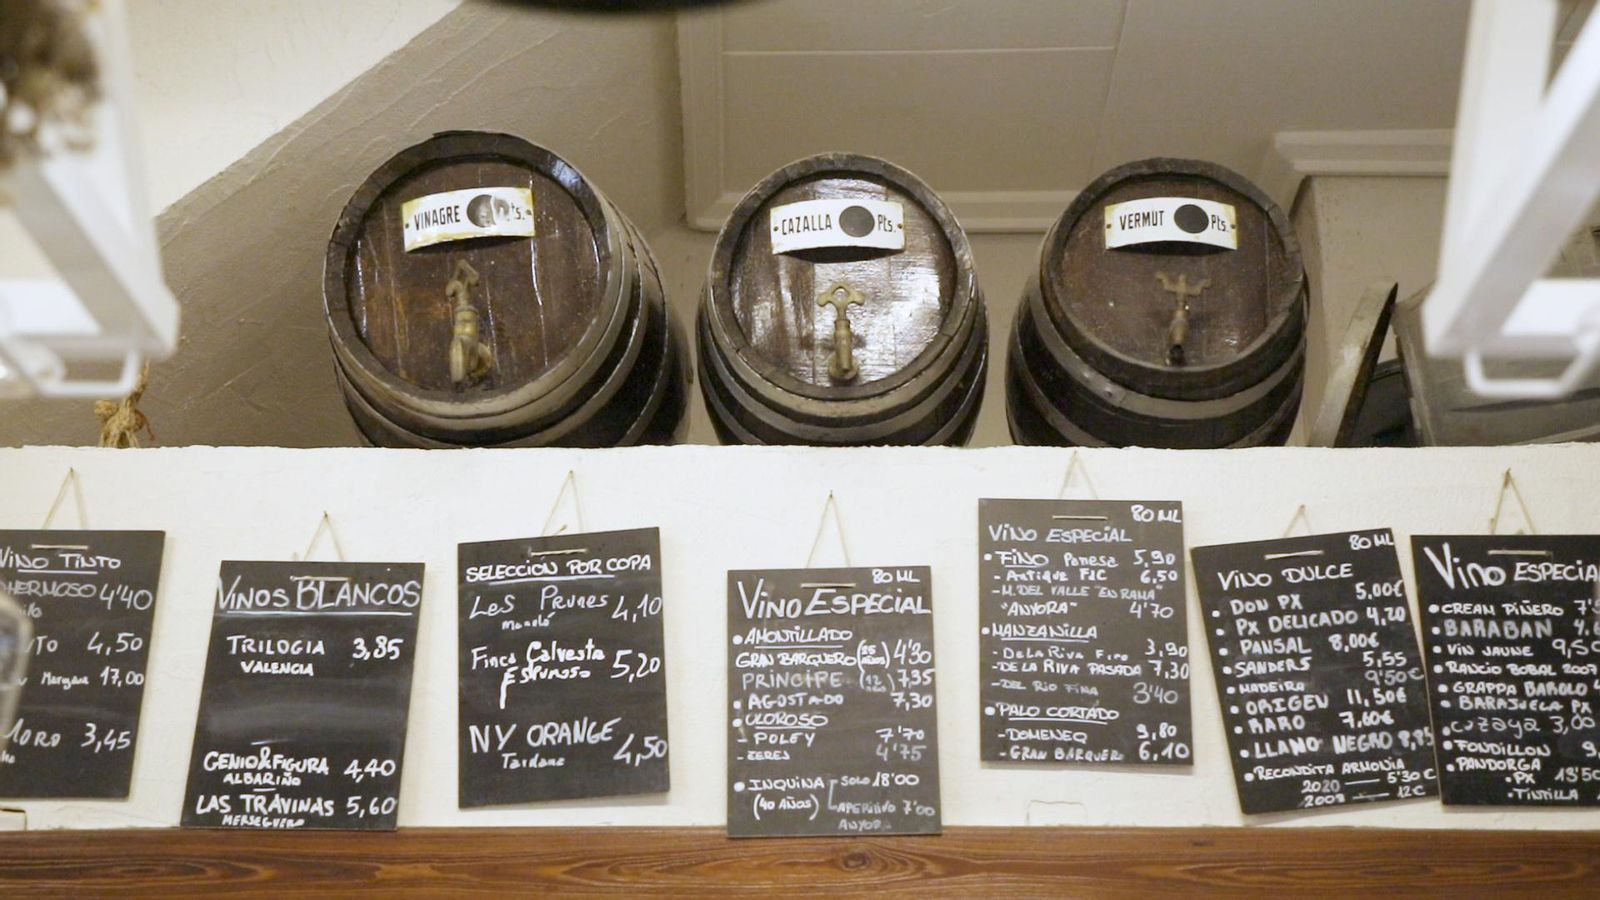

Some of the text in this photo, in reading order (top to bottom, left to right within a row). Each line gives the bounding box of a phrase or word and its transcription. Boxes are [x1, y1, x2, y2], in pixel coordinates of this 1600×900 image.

[414, 205, 460, 230] VINAGRE
[782, 214, 832, 235] CAZALLA
[1120, 210, 1164, 230] VERMUT
[1131, 505, 1153, 521] 80
[1349, 535, 1370, 550] 80
[566, 559, 601, 576] POR
[606, 555, 652, 571] COPA
[1281, 564, 1352, 583] DULCE
[1513, 560, 1600, 582] ESPECIA
[872, 569, 892, 584] 80
[296, 579, 422, 610] BLANCOS
[1277, 595, 1303, 610] PX
[1268, 610, 1358, 633] DELICADO
[87, 632, 143, 655] 4,50
[227, 635, 325, 655] TRILOGIA
[1240, 637, 1312, 655] PANSAL
[1482, 645, 1534, 656] JAUNE
[241, 660, 314, 677] VALENCIA
[735, 653, 773, 668] GRAN
[1087, 663, 1141, 676] PASADA
[1235, 657, 1312, 678] SANDERS
[1507, 663, 1557, 676] BOBAL
[1562, 663, 1597, 675] 2007
[1453, 681, 1517, 696] GRAPPA
[1524, 681, 1587, 697] BAROLO
[1571, 699, 1592, 714] PX
[82, 723, 131, 753] 3,45
[469, 724, 517, 753] NY
[527, 717, 622, 747] ORANGE
[754, 733, 815, 747] POLEY
[1010, 749, 1047, 760] GRAN
[1254, 732, 1392, 759] LLANO NEGRO
[1456, 757, 1541, 772] PANDORGA
[1513, 773, 1536, 784] PX
[196, 794, 232, 815] LAS
